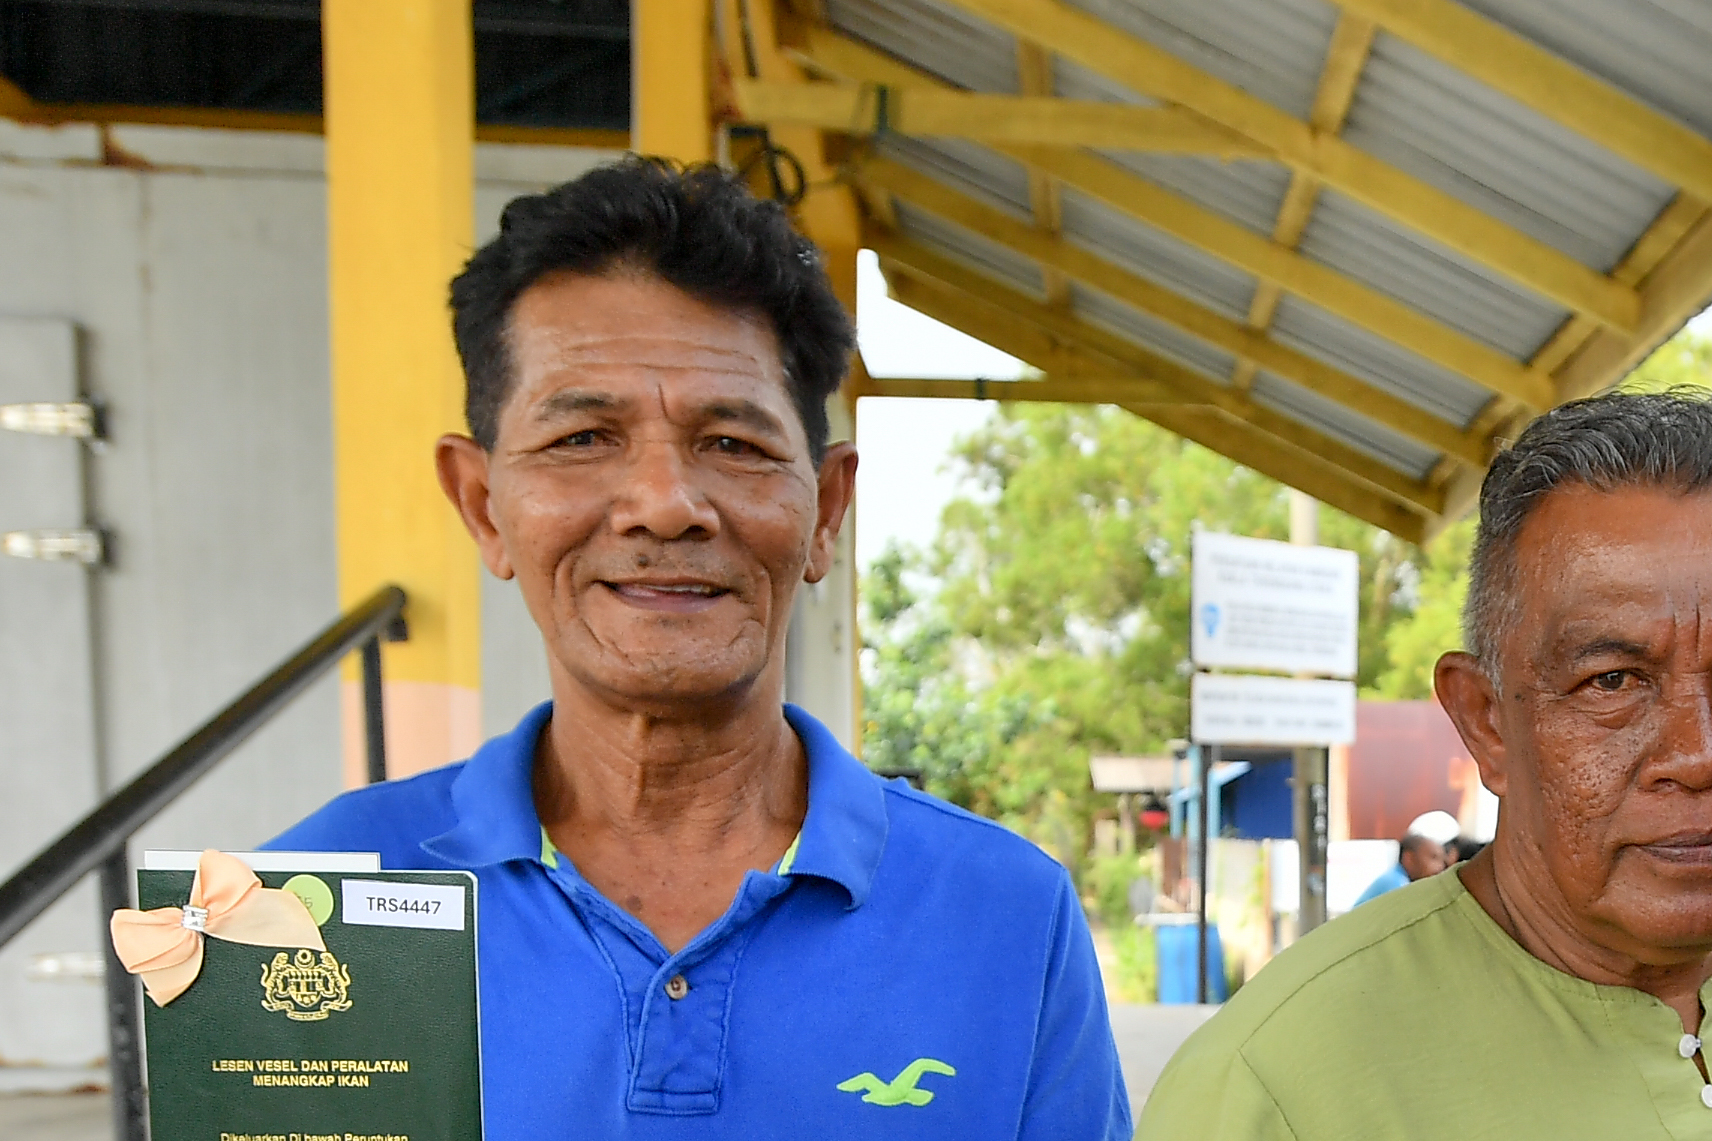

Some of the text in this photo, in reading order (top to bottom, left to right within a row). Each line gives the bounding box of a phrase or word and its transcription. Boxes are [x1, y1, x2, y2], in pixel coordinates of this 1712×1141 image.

[366, 897, 442, 915] TRS4447
[211, 1060, 409, 1073] LESEN VESEL DAN PERALATAN
[253, 1075, 369, 1087] MENANGKAP IKAN
